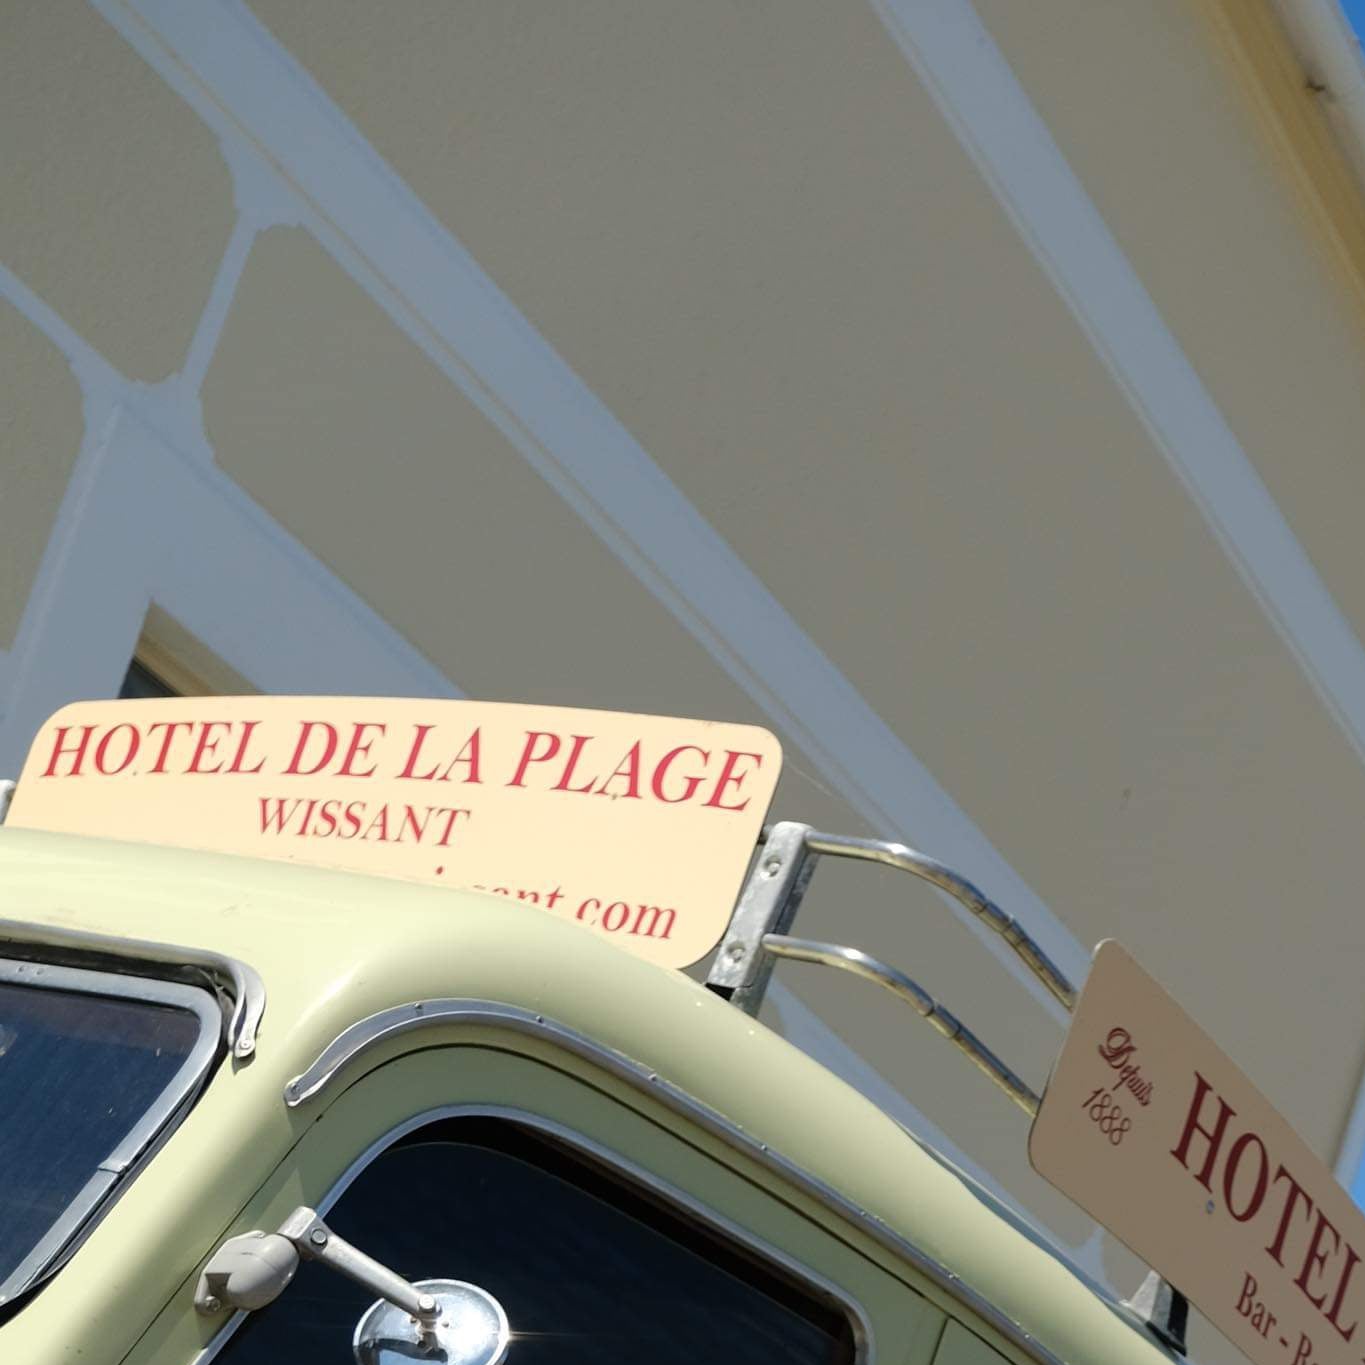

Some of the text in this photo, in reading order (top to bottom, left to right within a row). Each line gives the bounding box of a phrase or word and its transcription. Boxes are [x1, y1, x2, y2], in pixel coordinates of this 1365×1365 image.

[39, 719, 764, 812] HOTEL DE LA PLAGE
[257, 797, 471, 847] WISSANT
[1097, 1026, 1154, 1107] Depuis
[1081, 1087, 1132, 1146] 1888
[1168, 1070, 1363, 1344] HOTEL
[1234, 1271, 1278, 1340] Bar
